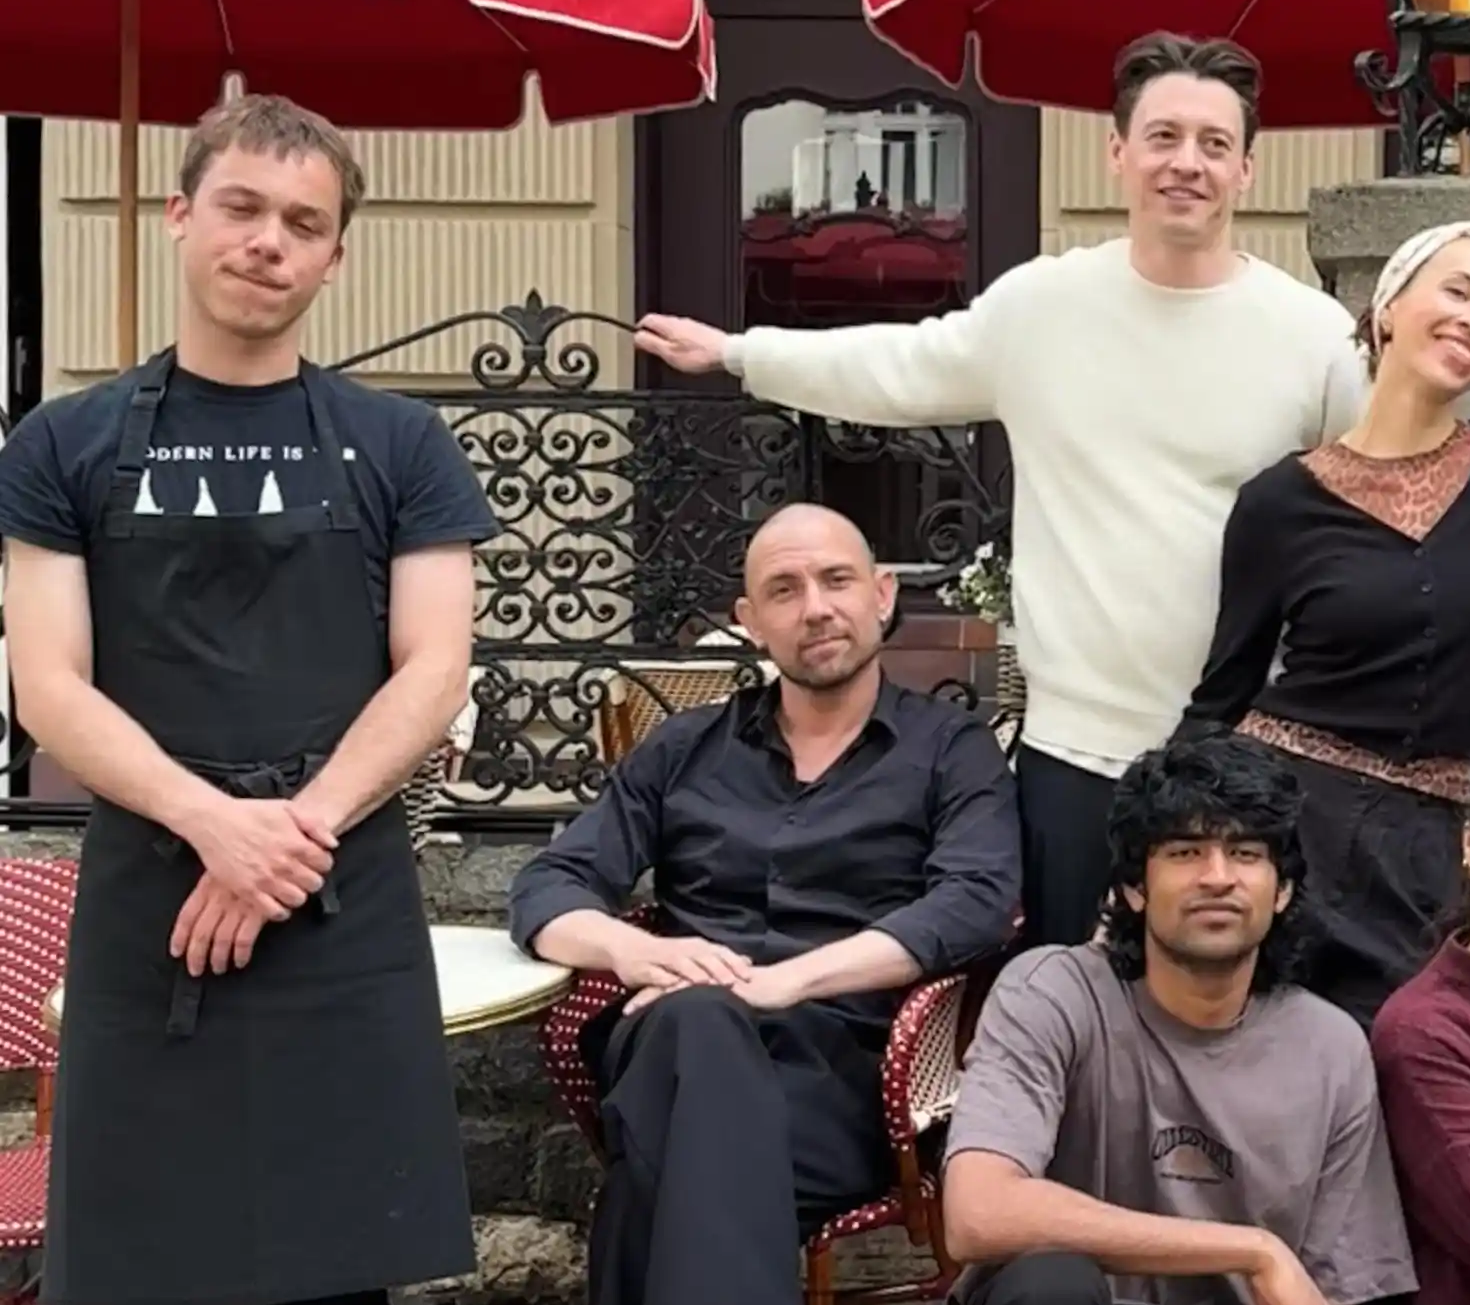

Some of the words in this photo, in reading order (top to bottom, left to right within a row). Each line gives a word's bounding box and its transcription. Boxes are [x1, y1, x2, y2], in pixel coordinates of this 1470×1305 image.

[145, 446, 214, 462] ODERN
[224, 446, 273, 461] LIFE
[283, 446, 304, 461] IS
